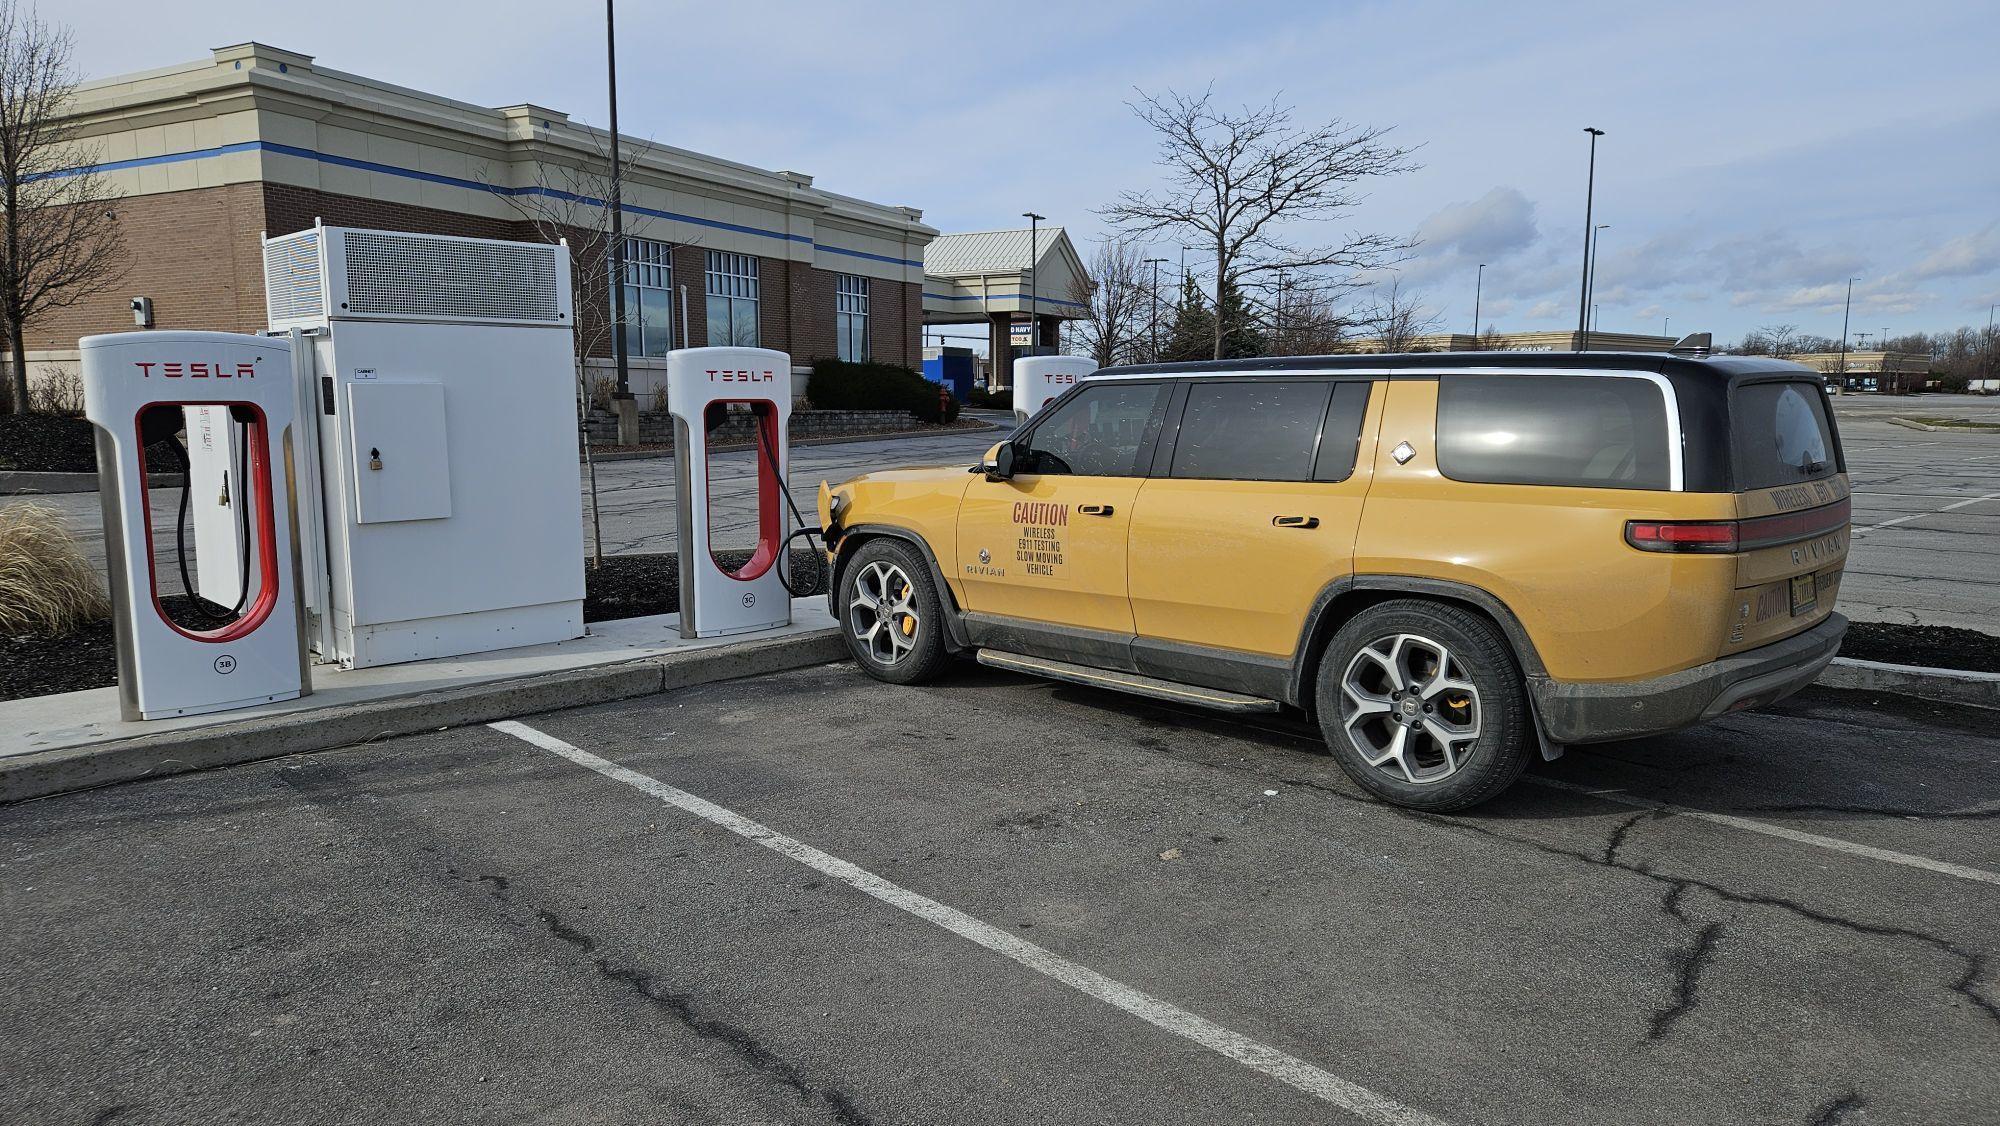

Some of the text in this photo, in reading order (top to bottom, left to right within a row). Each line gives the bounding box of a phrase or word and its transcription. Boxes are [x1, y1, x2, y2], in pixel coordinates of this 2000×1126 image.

[134, 362, 255, 378] TESLA
[705, 370, 773, 382] TESLA
[1044, 374, 1088, 384] TESL
[1013, 501, 1069, 527] CAUTION
[1023, 526, 1056, 540] WIRELESS
[1018, 538, 1061, 553] E911 TESTING
[1790, 535, 1841, 566] RIVIAN
[1016, 550, 1063, 565] SLOW MOVING
[966, 564, 1005, 577] RIVIAN
[1026, 563, 1054, 576] VEHICLE
[744, 596, 753, 604] 3C
